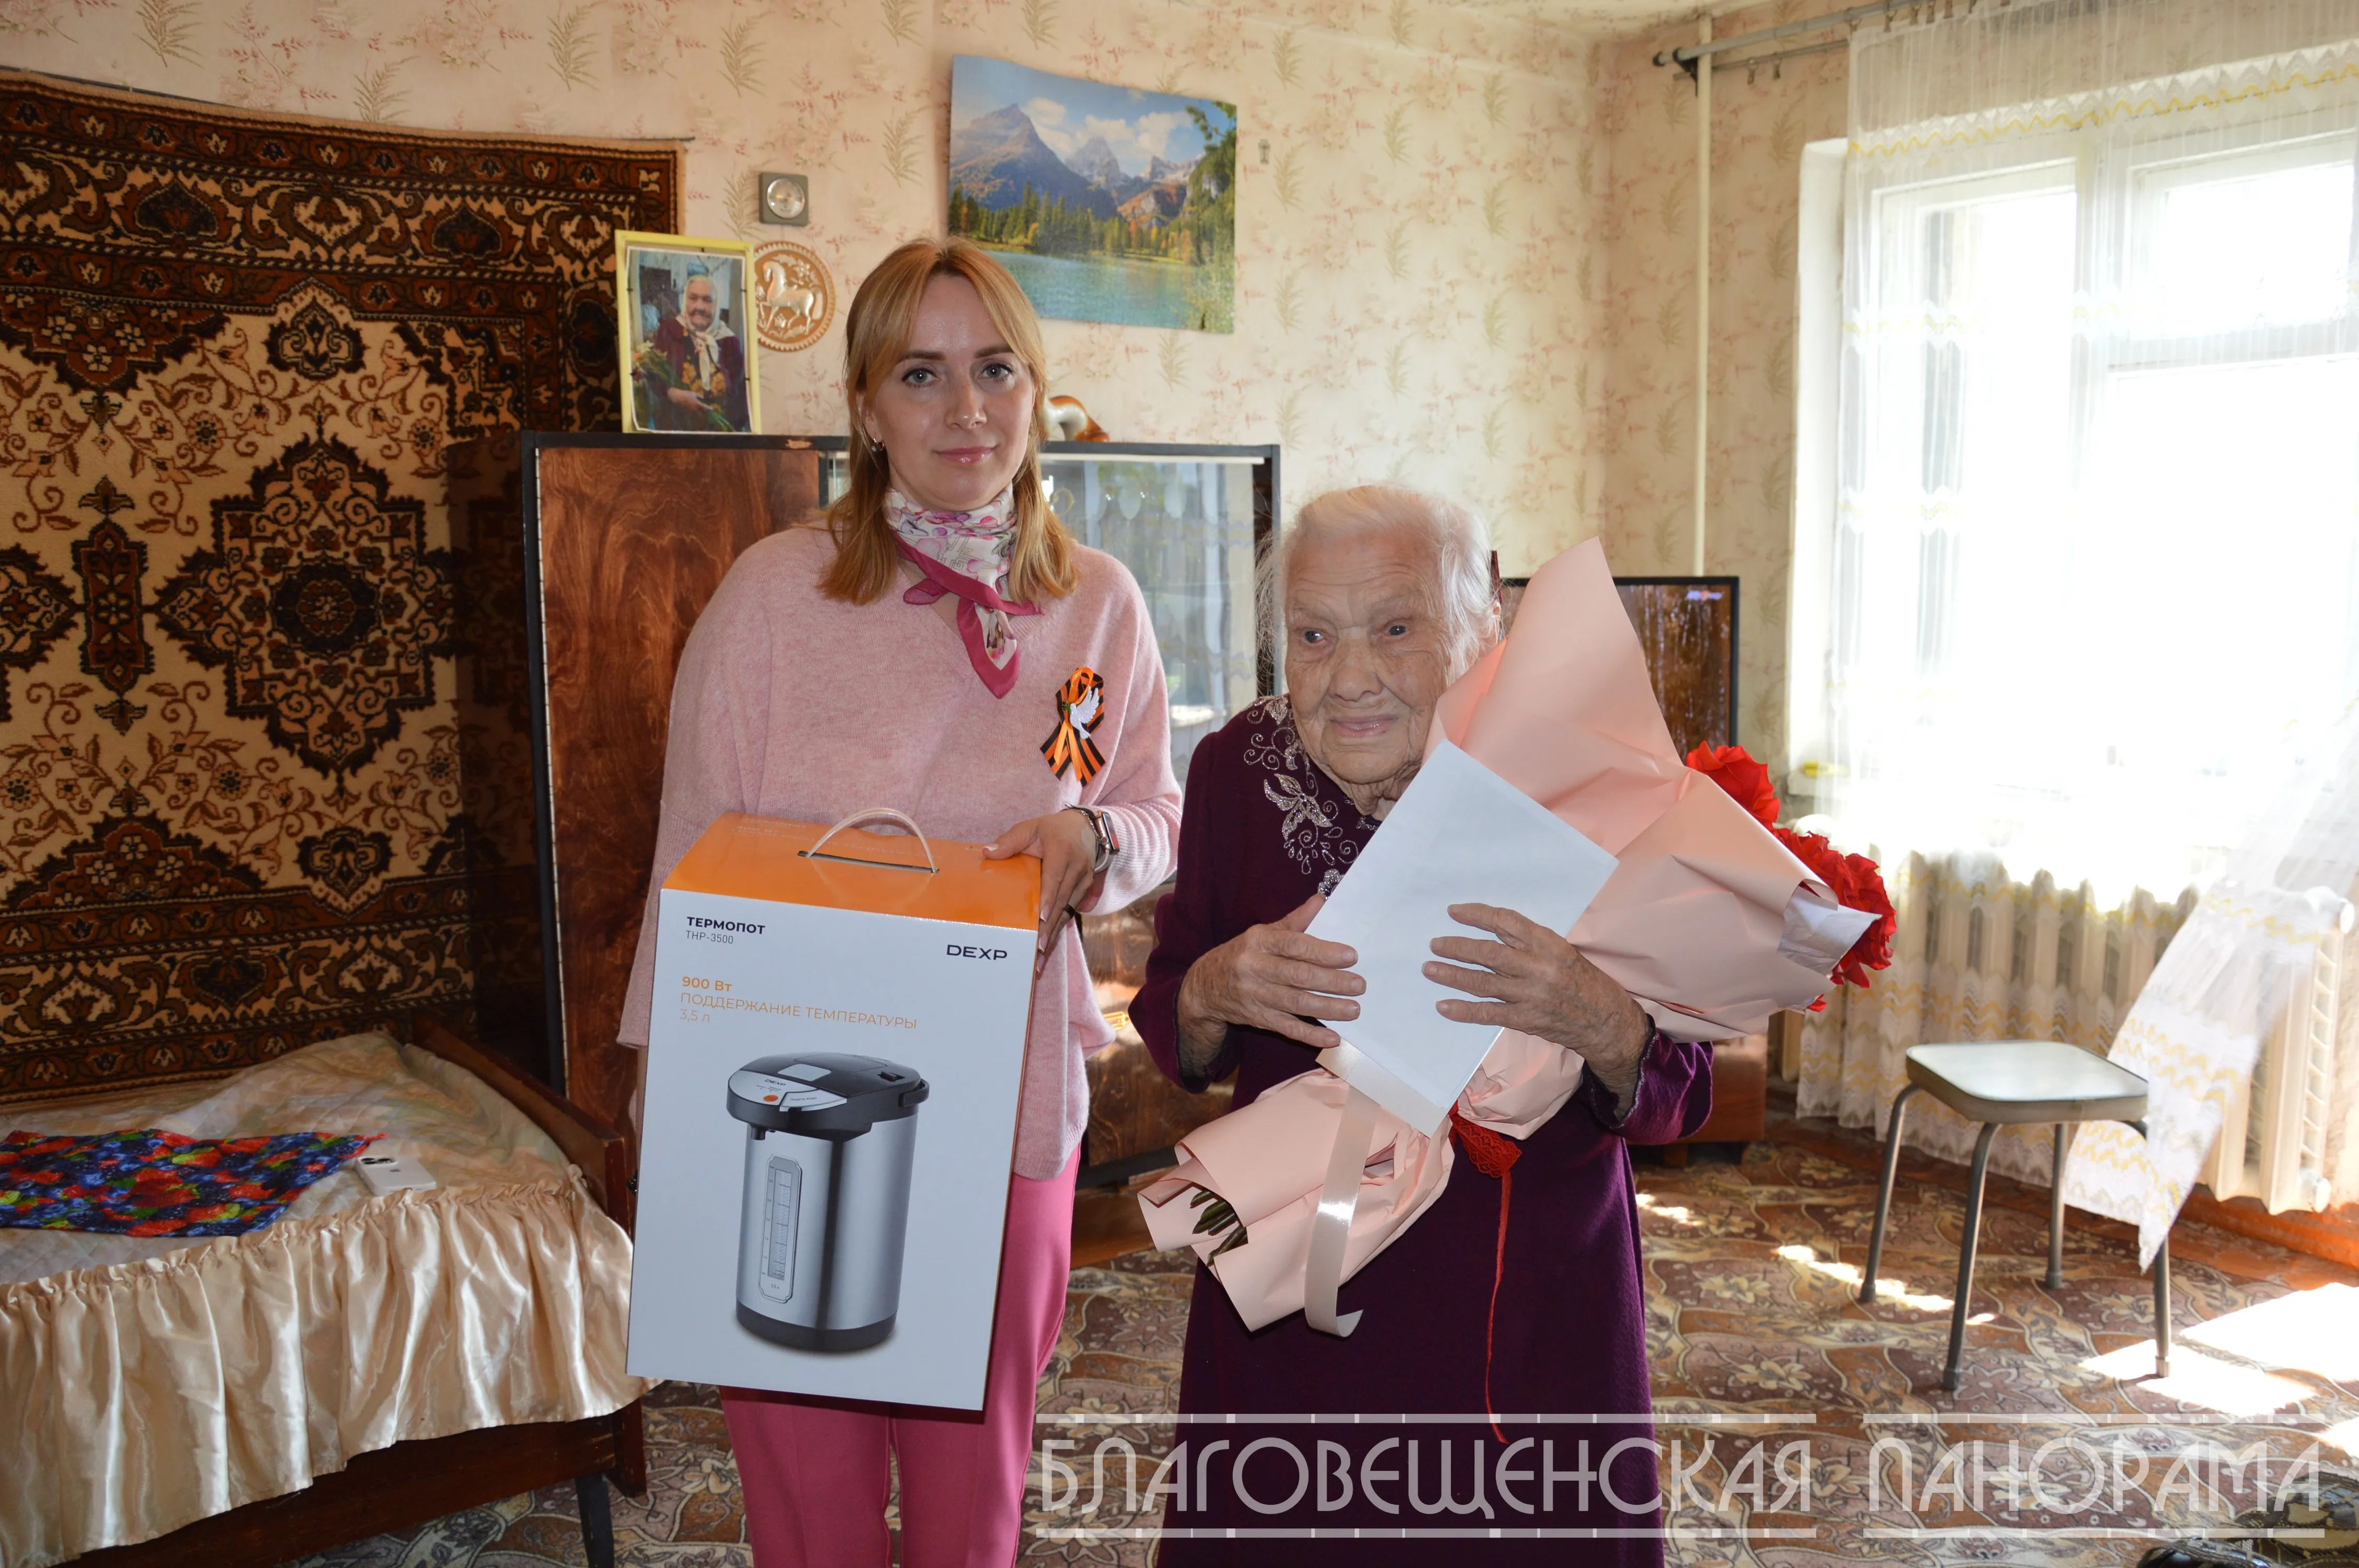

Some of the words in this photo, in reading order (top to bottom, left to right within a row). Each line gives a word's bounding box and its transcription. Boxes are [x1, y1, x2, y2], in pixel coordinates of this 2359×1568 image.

[686, 916, 765, 935] ТЕРМОПОТ
[685, 930, 734, 944] THP-3500
[946, 944, 1008, 961] DEXP
[682, 976, 710, 989] 900
[714, 980, 732, 992] Вт
[679, 1008, 698, 1022] 3,5
[680, 992, 801, 1017] ПОДДЕРЖАНИЕ
[805, 1006, 918, 1029] ТЕМПЕРАТУРЫ
